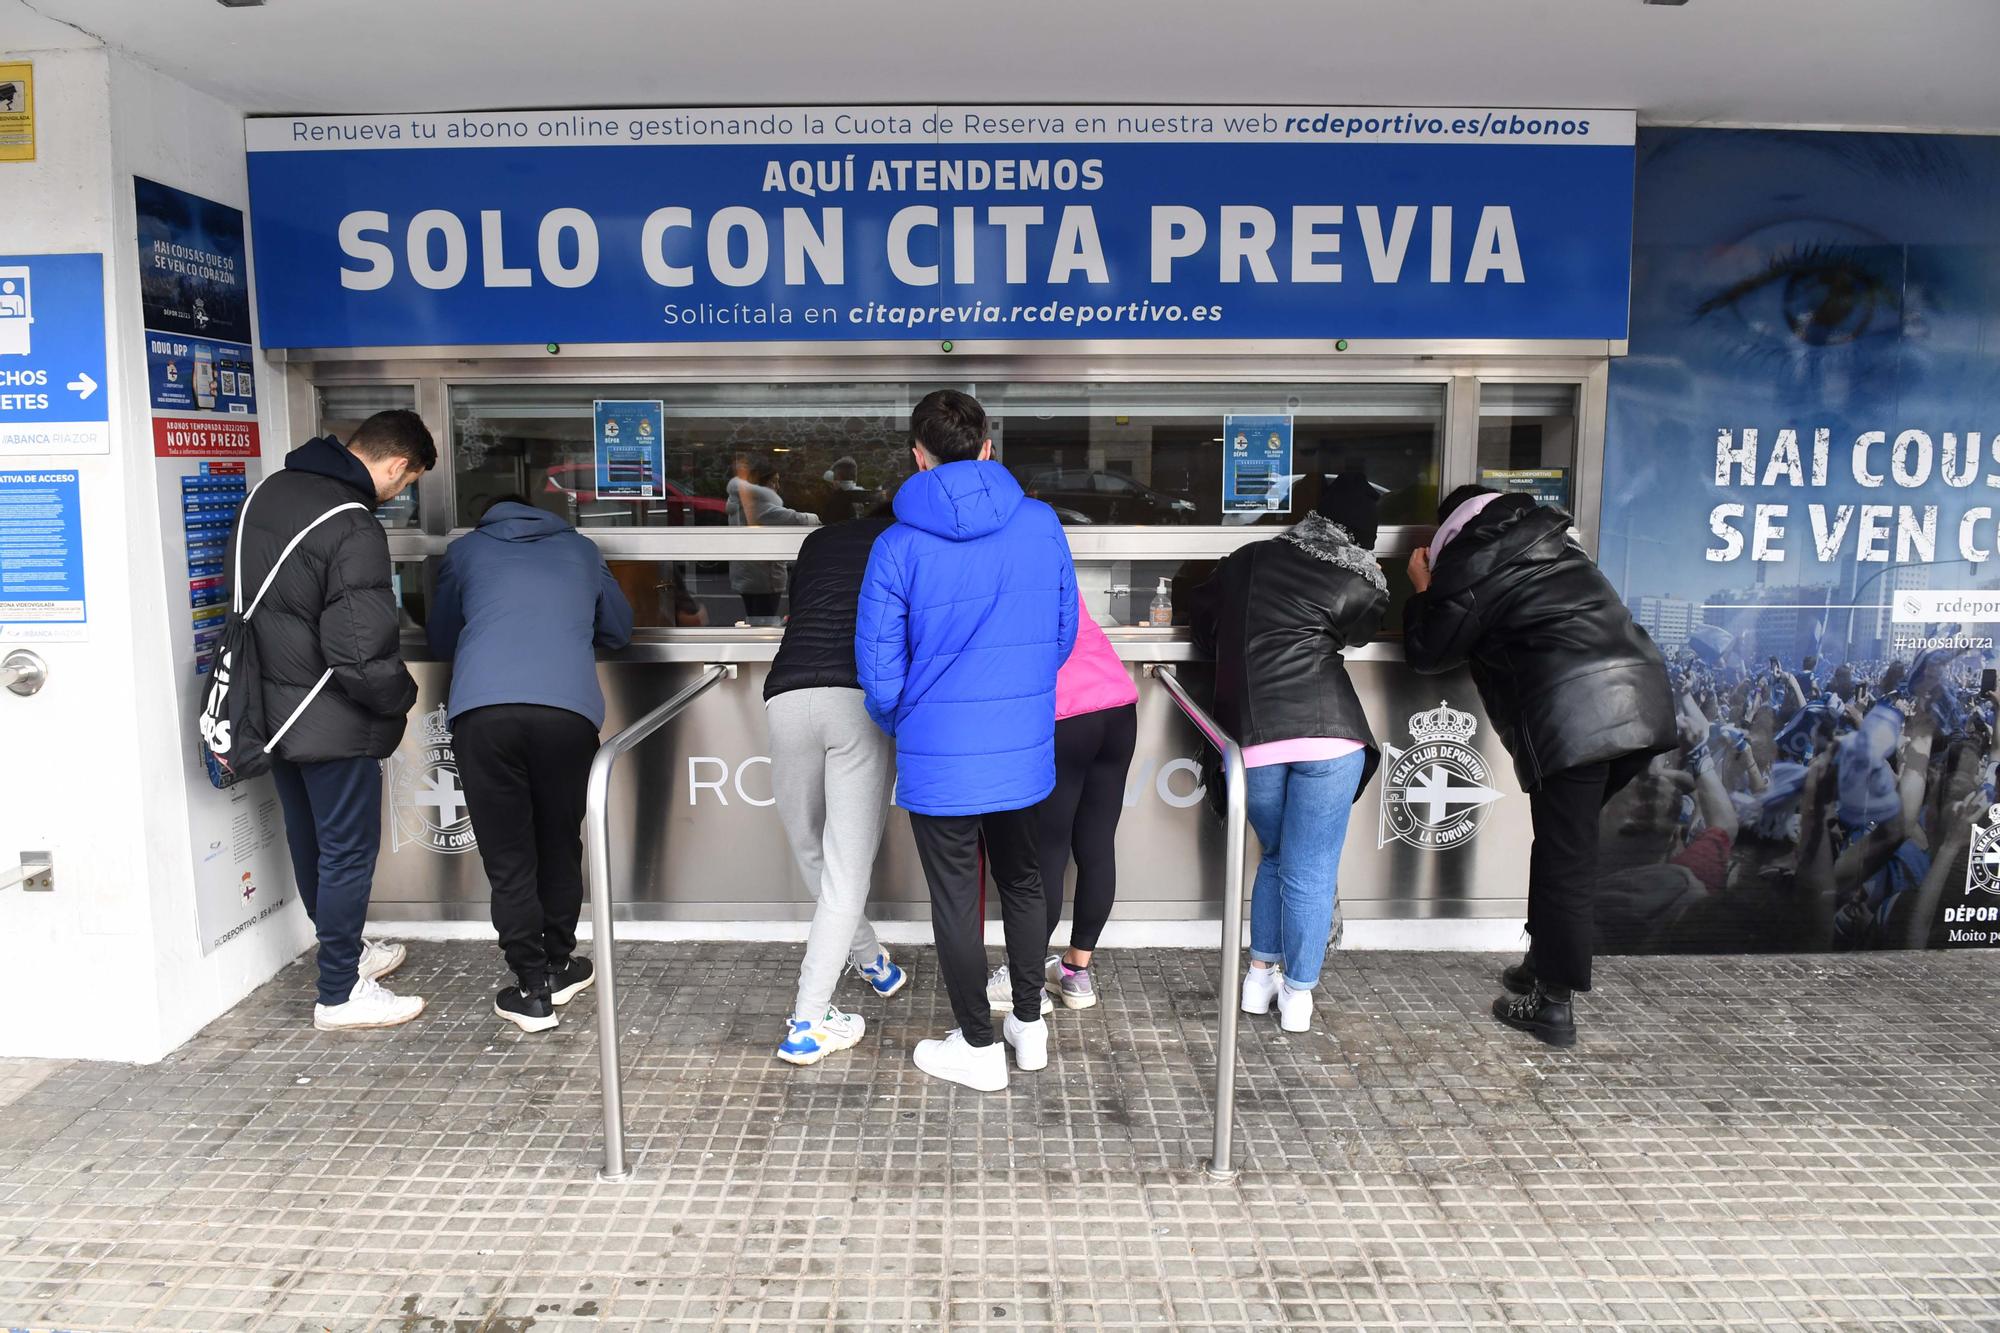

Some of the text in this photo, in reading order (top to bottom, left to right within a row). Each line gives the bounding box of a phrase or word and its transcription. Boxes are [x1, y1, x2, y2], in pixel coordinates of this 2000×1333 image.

[292, 112, 1590, 141] Renueva tu abono online gestionando la Cuota de Reserva en nuestra web rcdeportivo.es/abonos
[762, 154, 1104, 197] AQUÍ ATENDEMOS
[154, 240, 234, 270] HAI COUSAS QUE SÓ
[337, 205, 1525, 291] SOLO CON CITA PREVIA
[154, 255, 235, 285] SE VEN CO CORAZÓN
[663, 300, 1223, 328] Solicítala en citaprevia.rcdeportivo.es
[173, 343, 188, 357] APP
[166, 421, 189, 430] ABONOS
[190, 423, 222, 431] TEMPORADA
[52, 432, 97, 444] RIAZOR
[167, 431, 250, 447] NOVOS PREZOS
[1714, 428, 1831, 487] HAI
[24, 475, 37, 483] DE
[38, 474, 75, 482] ACCESO
[1705, 503, 2000, 563] SE VEN C
[1893, 632, 1993, 651] #anosaforza
[1392, 746, 1485, 785] REAL CLUB DEPORTIVO
[433, 829, 476, 847] LA CORU
[1419, 819, 1475, 843] LA CORUÑA
[1976, 835, 1992, 852] REAL
[1944, 904, 1999, 922] DÉPOR
[1948, 929, 1987, 942] Moito
